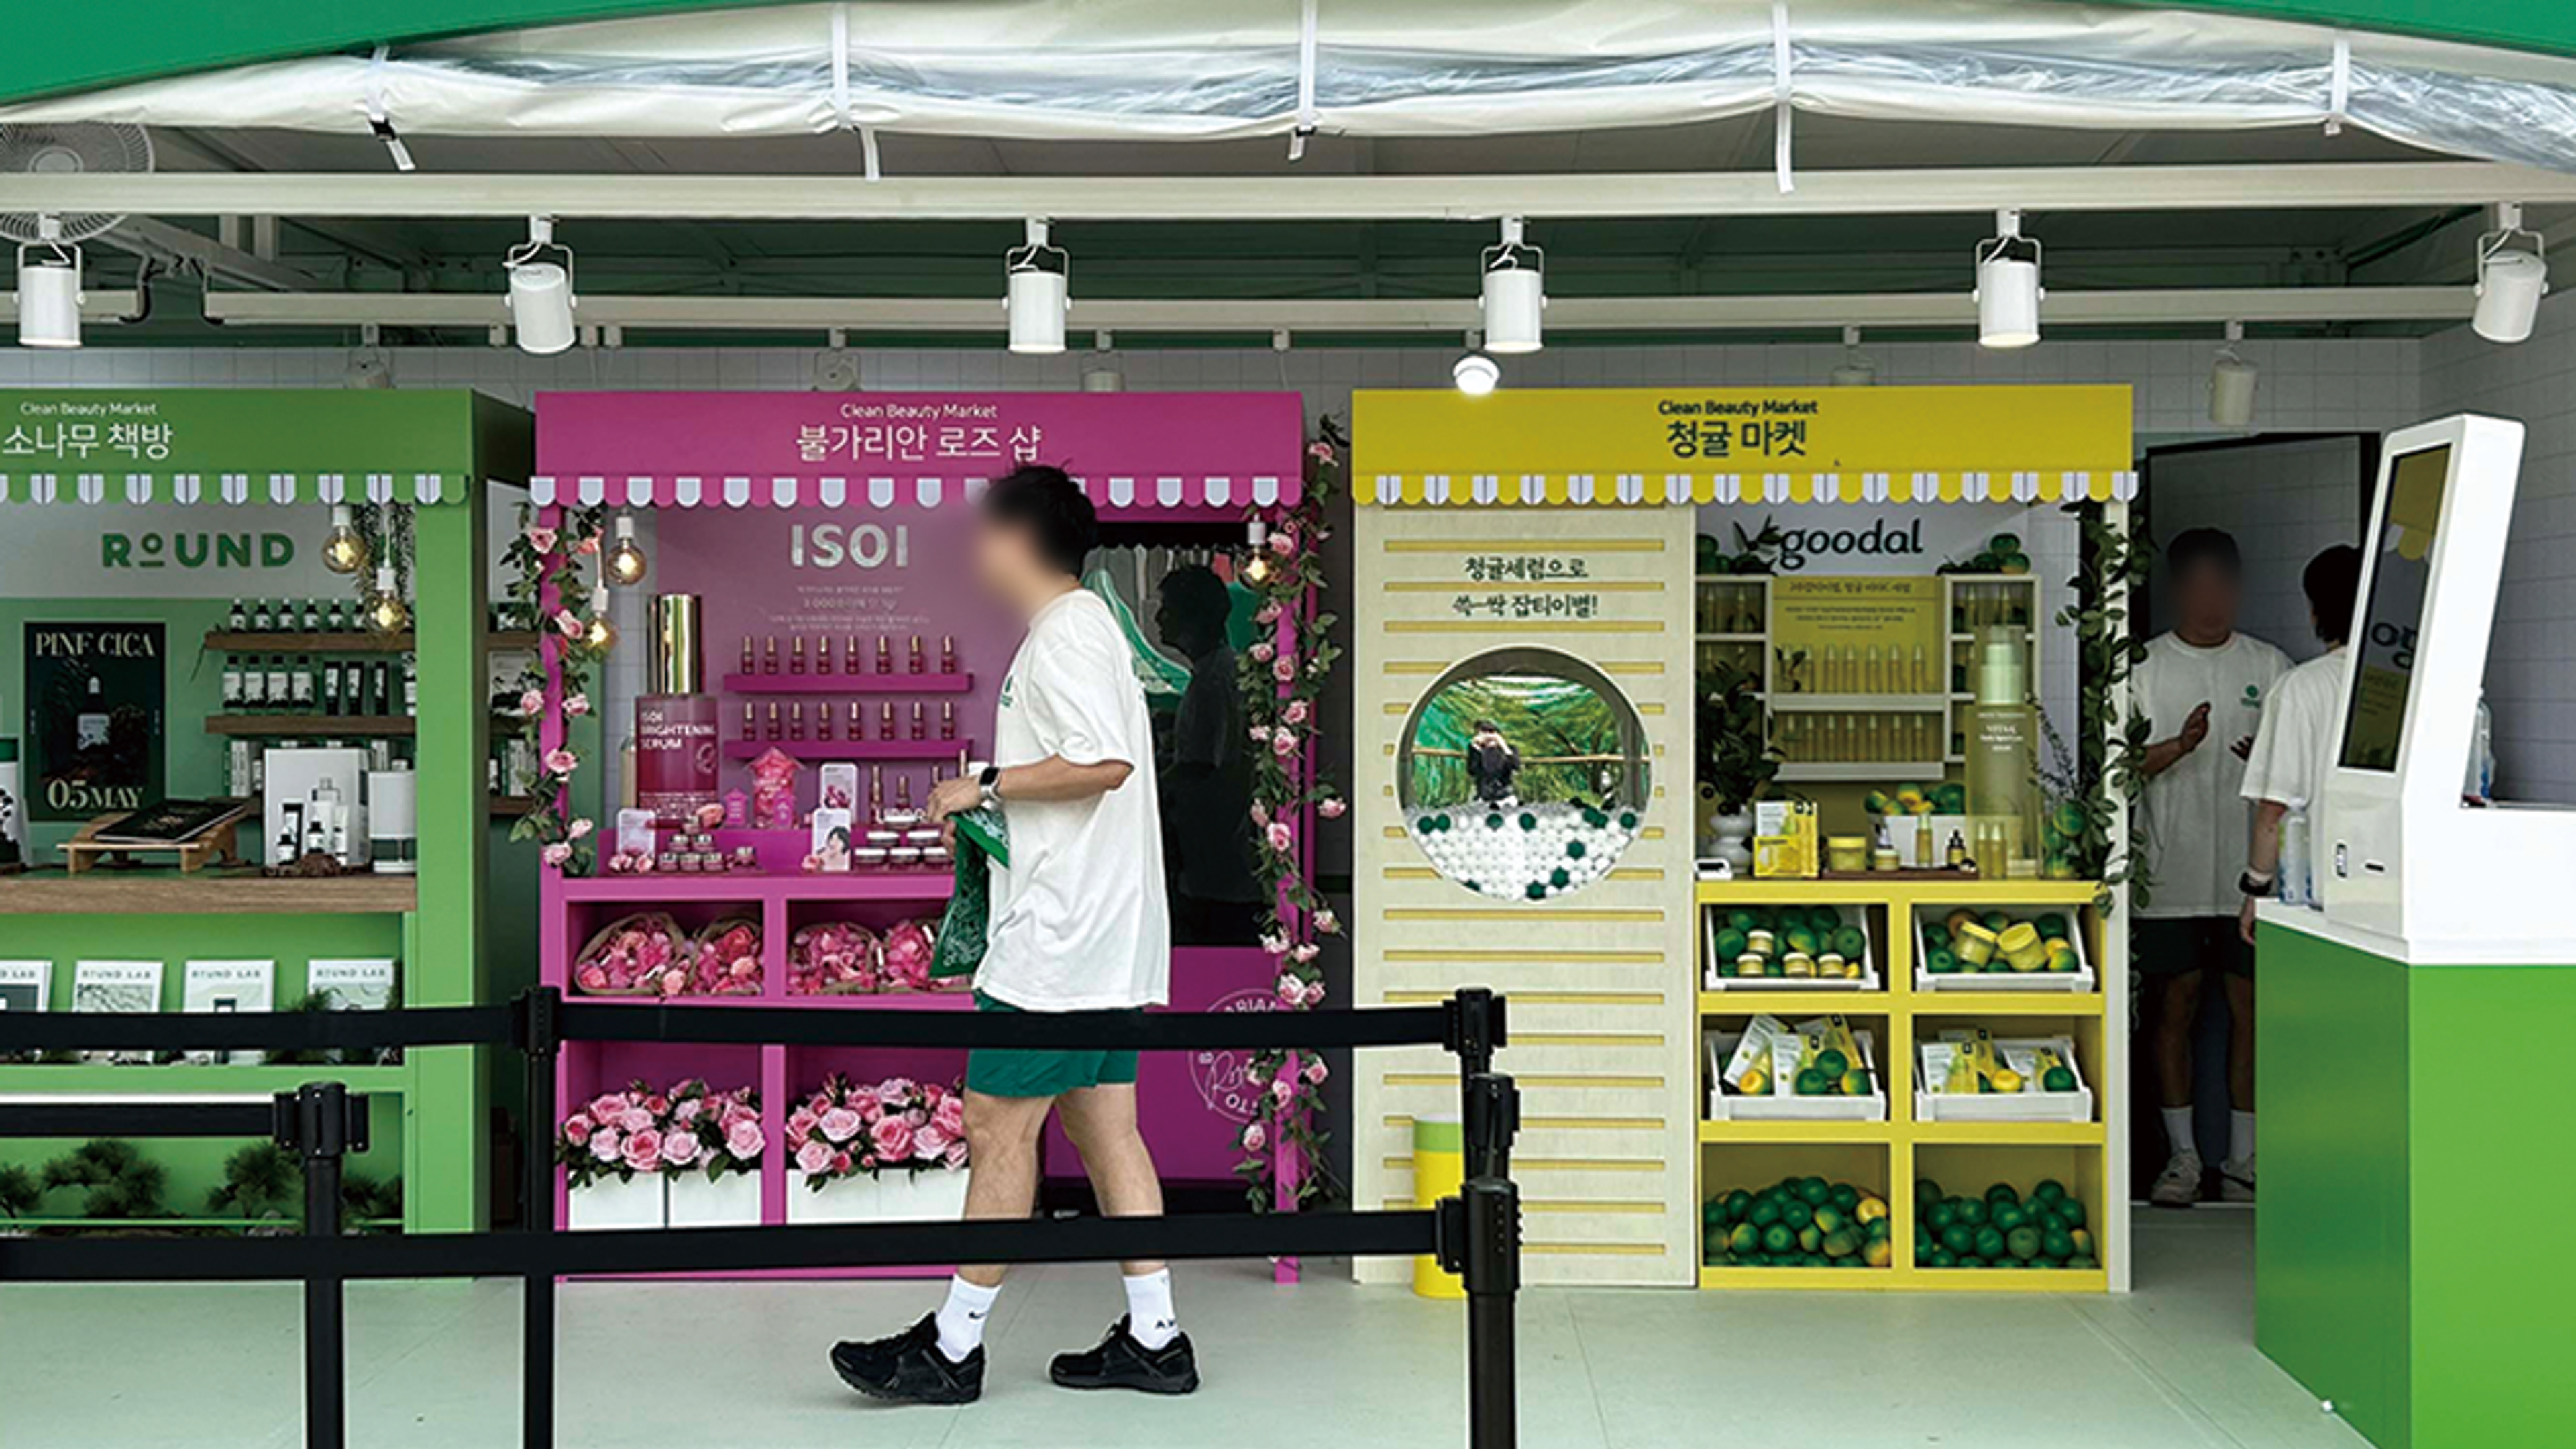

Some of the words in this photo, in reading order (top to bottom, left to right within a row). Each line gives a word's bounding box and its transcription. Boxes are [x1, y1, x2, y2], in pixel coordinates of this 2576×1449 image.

[21, 402, 57, 415] Clean
[60, 402, 106, 417] Beauty
[109, 402, 158, 415] Market
[841, 404, 884, 418] Clean
[886, 405, 940, 421] Beauty
[943, 404, 998, 418] Market
[1658, 400, 1701, 415] Clean
[1705, 400, 1759, 417] Beauty
[1762, 400, 1818, 415] Market
[2, 421, 99, 459] 소나무
[107, 421, 174, 460] 책방
[796, 424, 928, 462] 불가리안
[935, 427, 1001, 458] 로즈
[1009, 425, 1042, 462] 샵
[1666, 420, 1733, 458] 청귤
[1741, 420, 1807, 457] 마켓
[791, 524, 909, 568] ISOI
[1779, 518, 1923, 570] goodal
[1464, 555, 1589, 582] 청귤세럼으로
[1511, 593, 1599, 618] 잡티이별!
[98, 631, 156, 657] CICA
